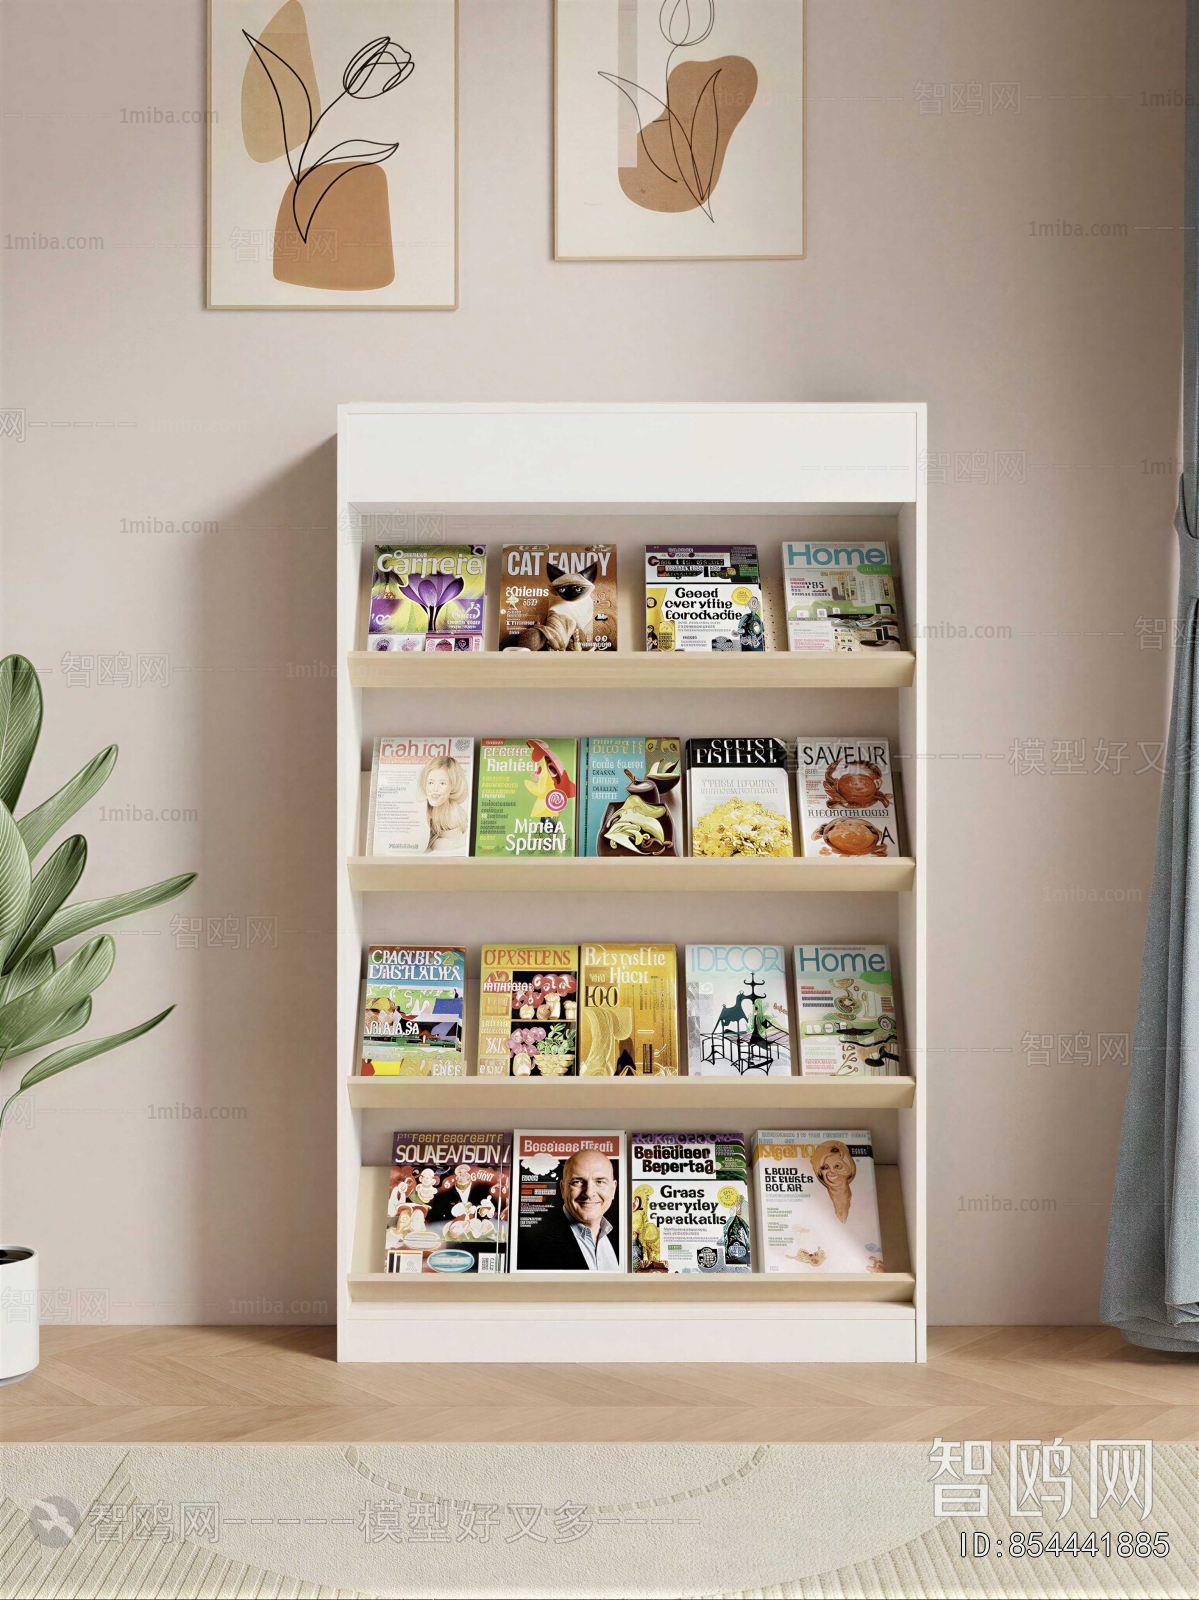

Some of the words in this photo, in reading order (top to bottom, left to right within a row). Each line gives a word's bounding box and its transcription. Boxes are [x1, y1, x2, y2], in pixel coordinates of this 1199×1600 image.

[508, 551, 545, 576] CAT
[787, 544, 886, 566] Home
[799, 947, 886, 973] Home
